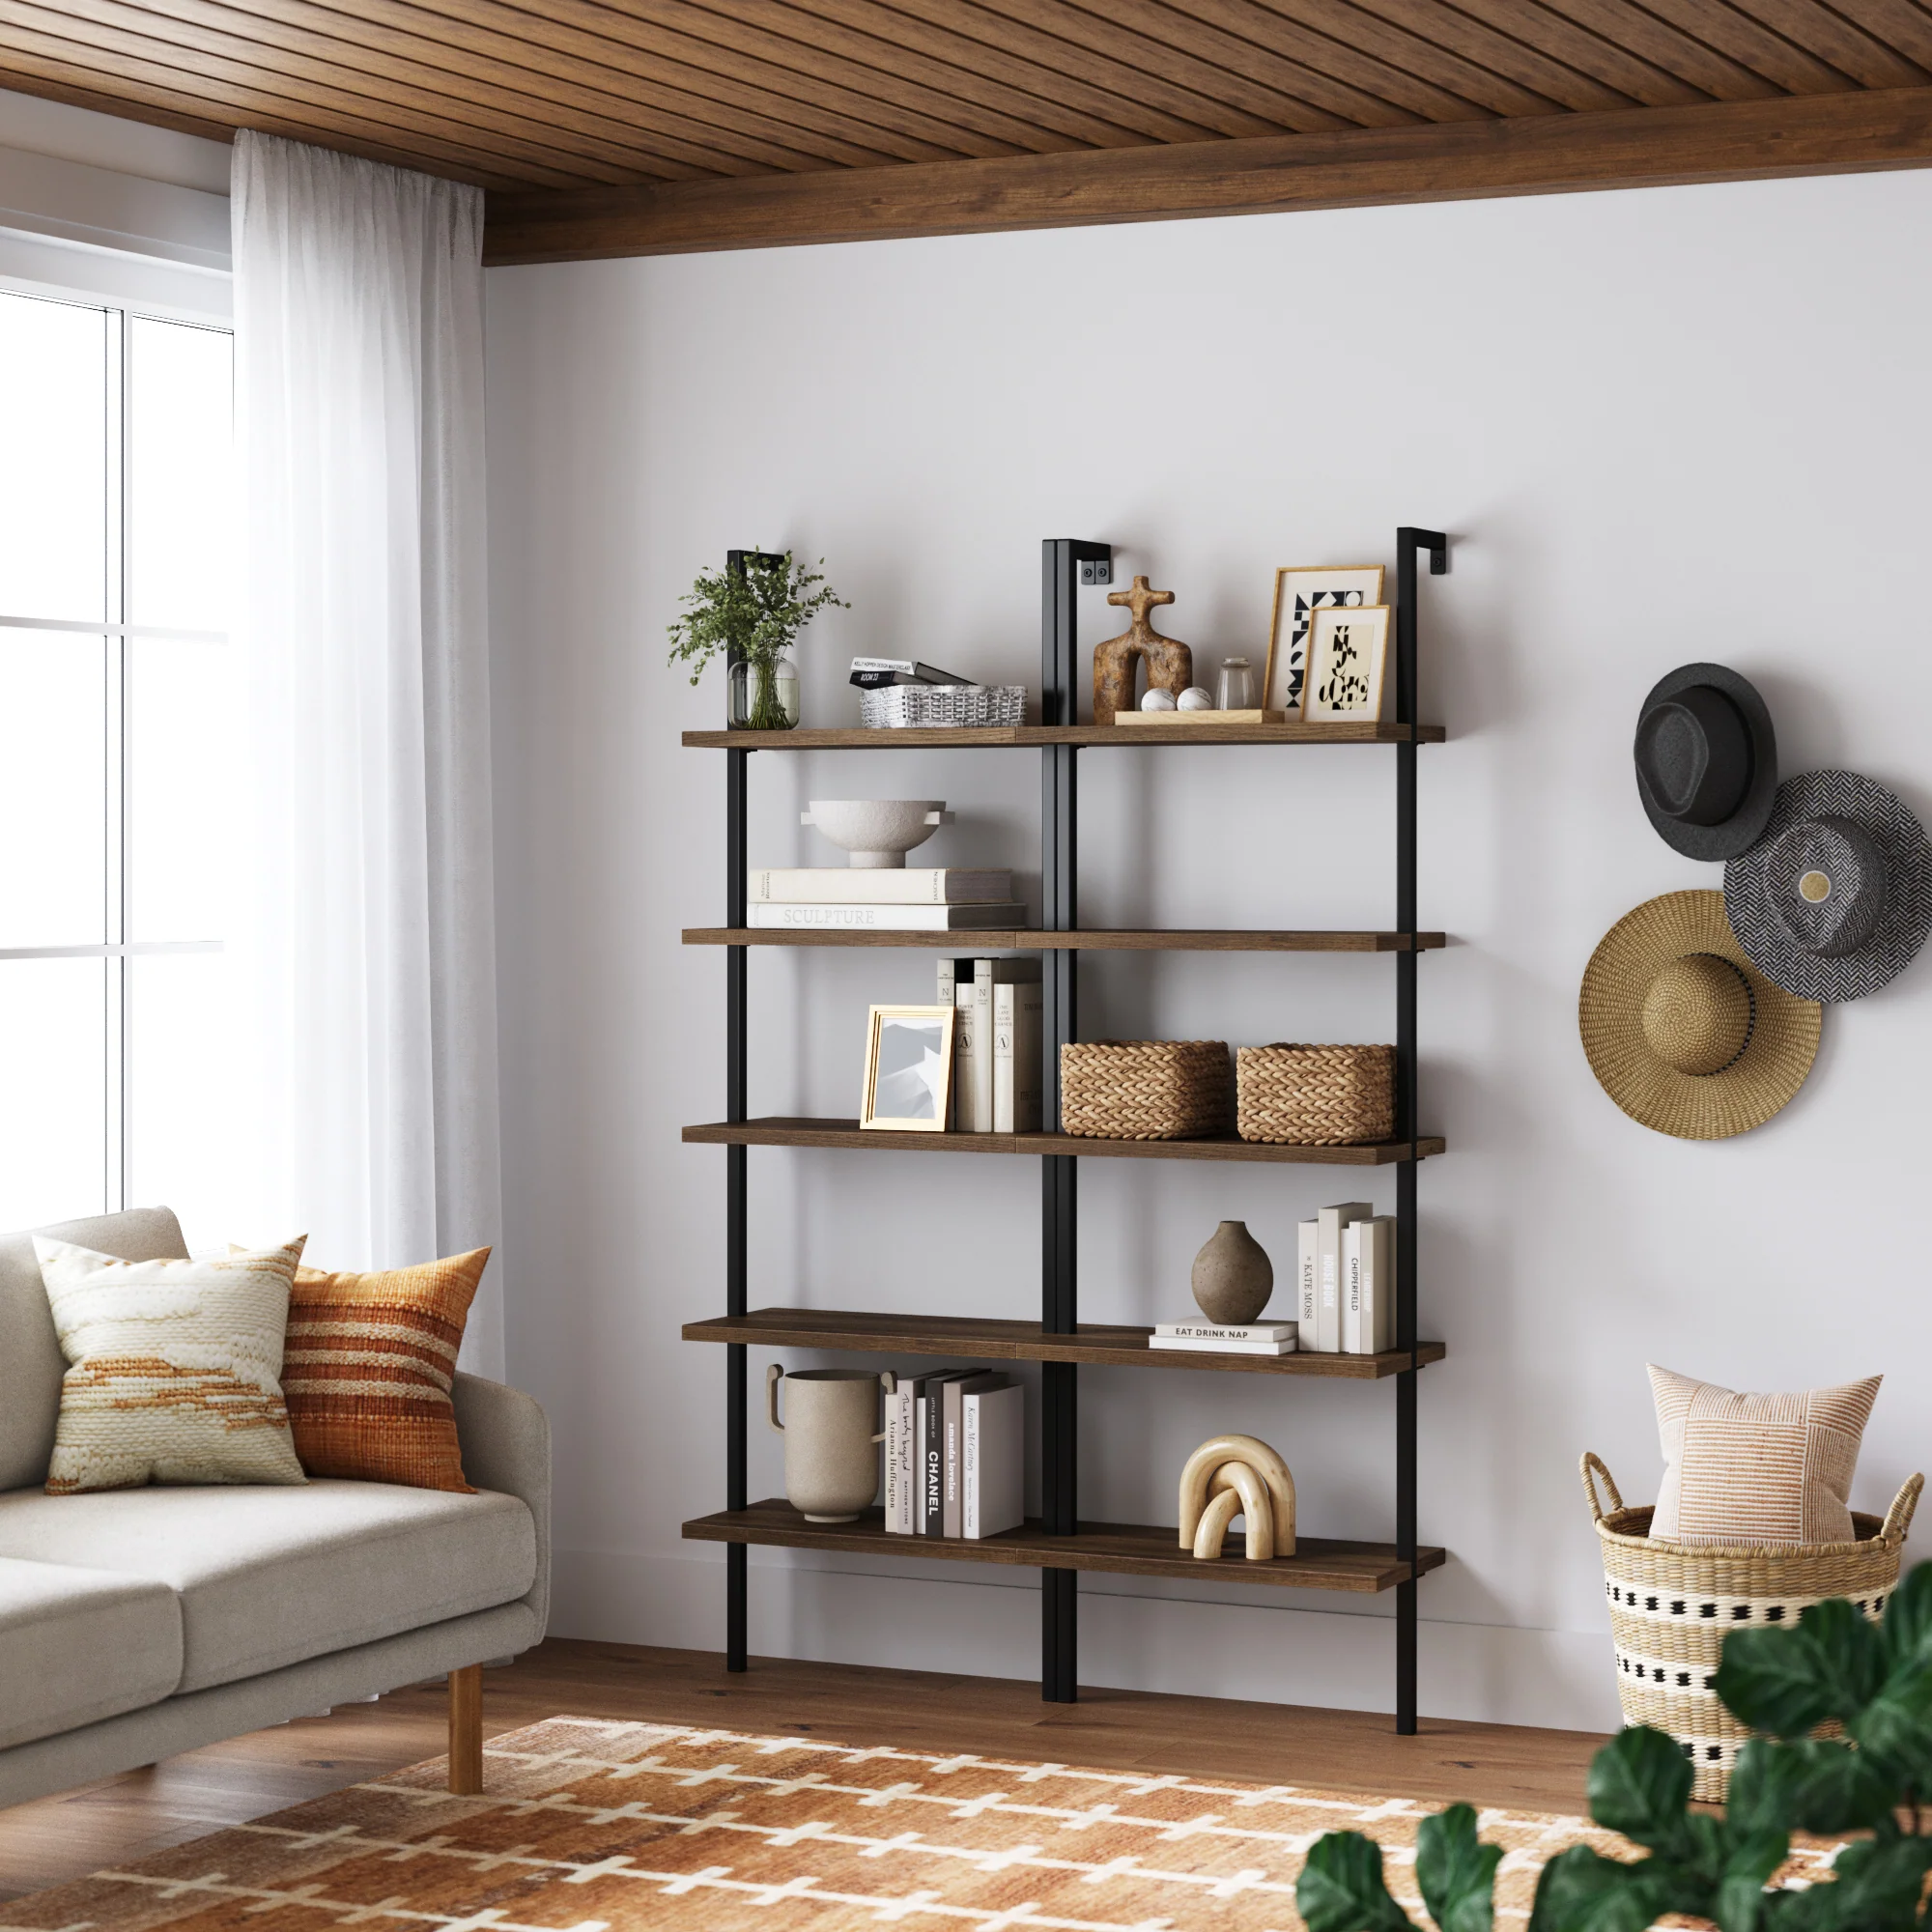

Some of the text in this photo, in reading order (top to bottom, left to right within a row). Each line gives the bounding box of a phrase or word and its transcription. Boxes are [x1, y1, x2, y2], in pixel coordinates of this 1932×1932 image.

[783, 909, 875, 924] SCULPTURE
[1304, 1264, 1312, 1319] KATE MOSS
[1323, 1254, 1334, 1308] HOUSE BOOK
[1175, 1327, 1248, 1339] EAT DRINK NAP
[967, 1407, 976, 1429] Karen
[966, 1431, 975, 1471] McCartney
[888, 1459, 897, 1508] Huffington
[929, 1451, 939, 1516] CHANEL
